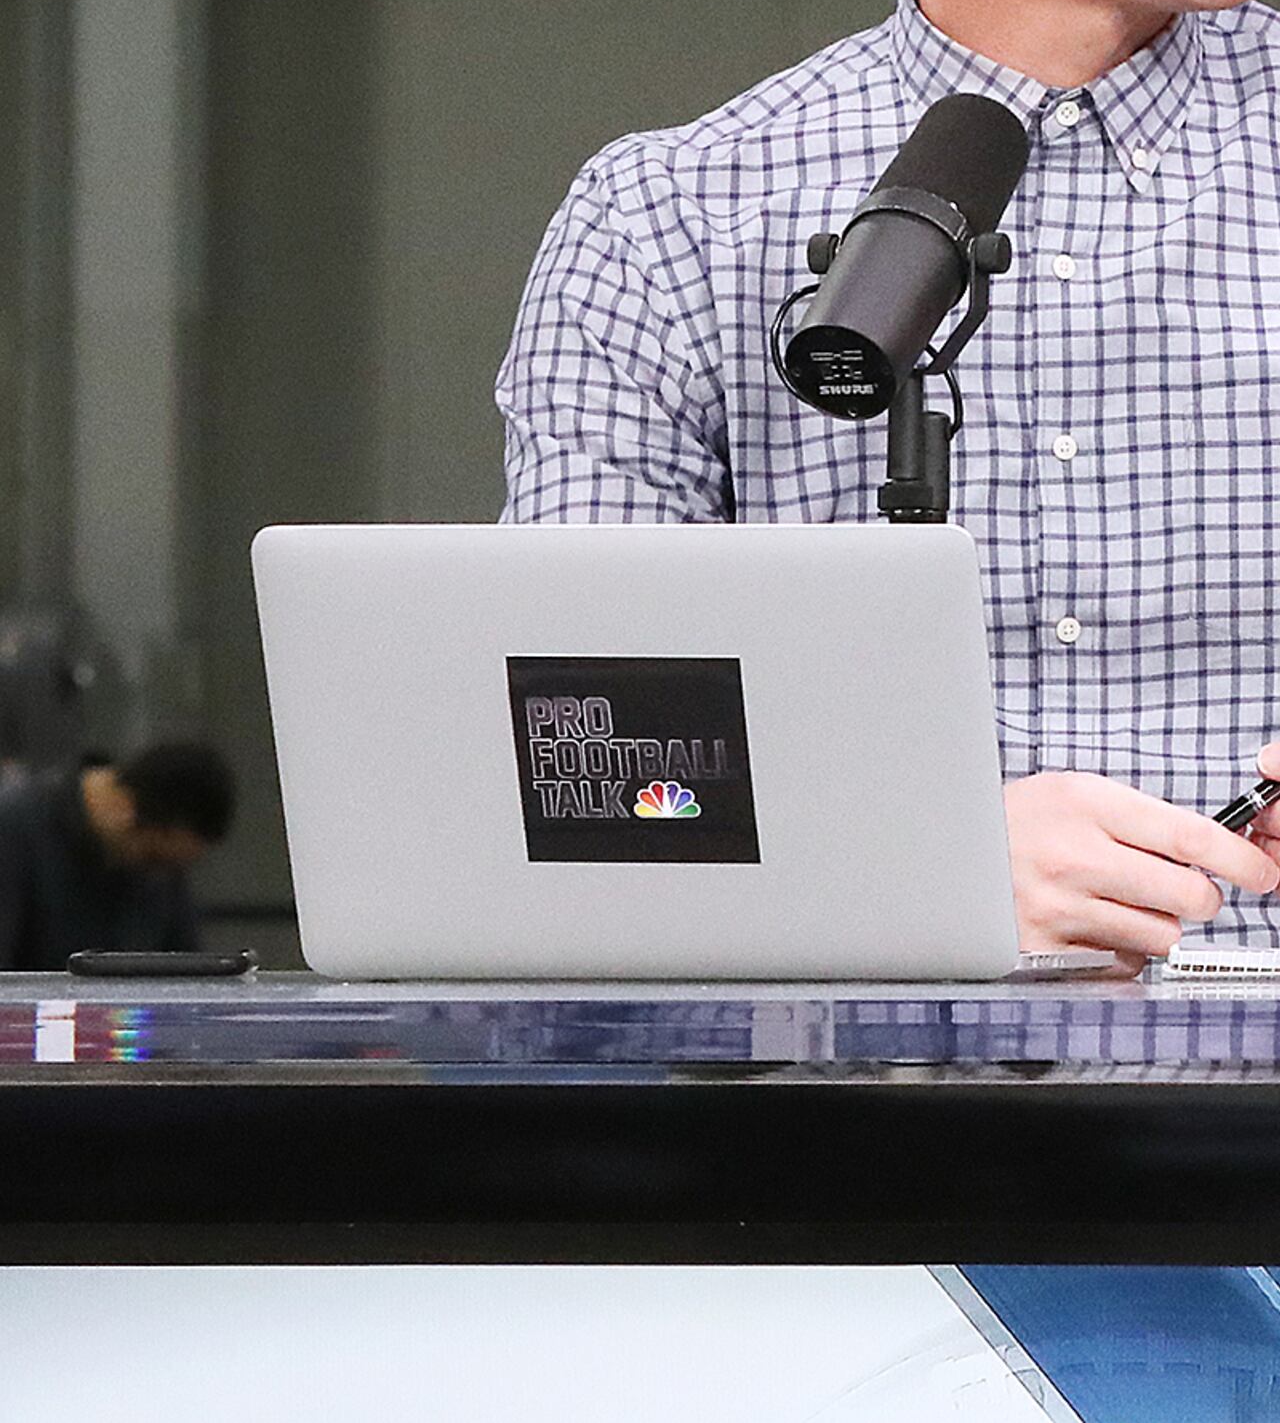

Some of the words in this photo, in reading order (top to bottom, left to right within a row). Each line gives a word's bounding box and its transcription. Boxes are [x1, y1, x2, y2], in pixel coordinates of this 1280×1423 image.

[526, 696, 614, 740] PRO
[529, 738, 731, 781] FOOTBALL
[533, 780, 631, 819] TALK
